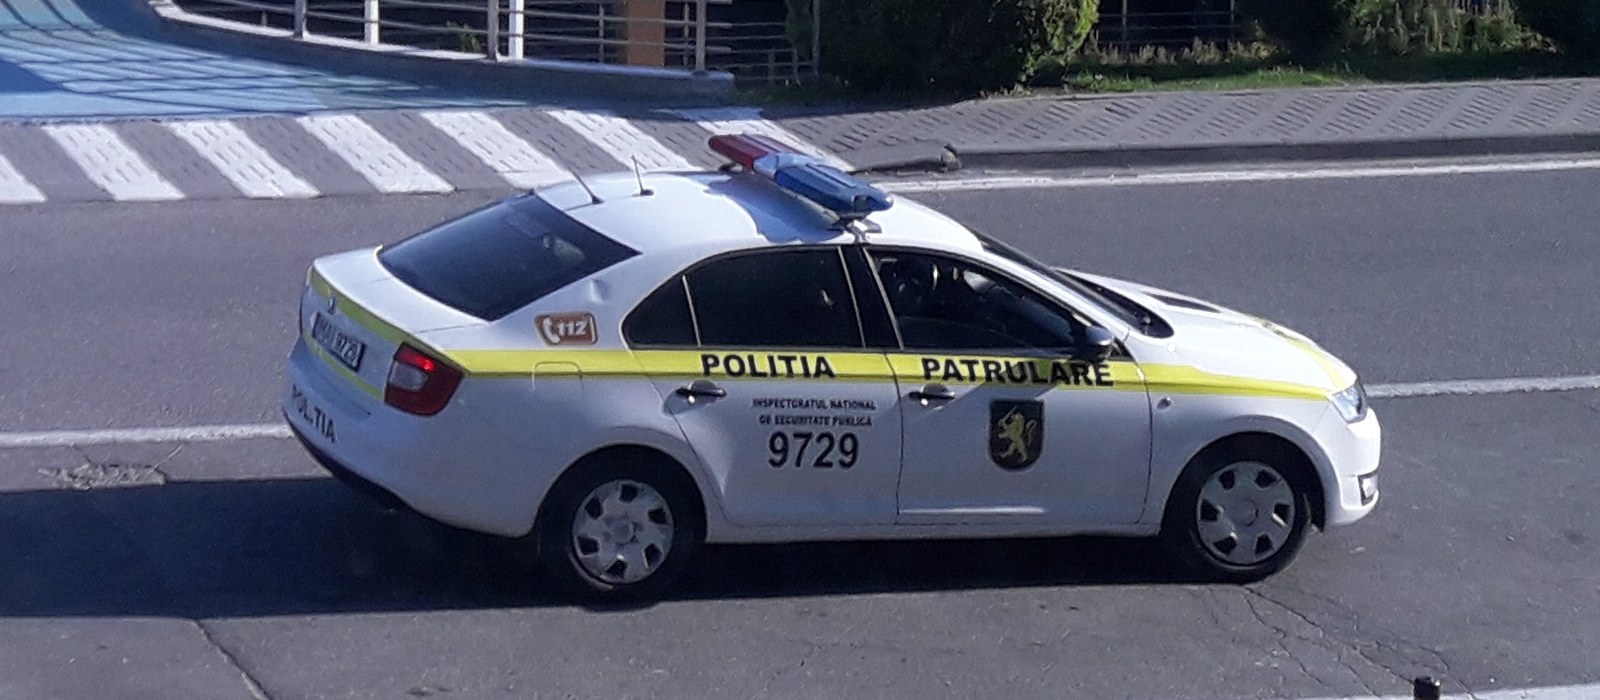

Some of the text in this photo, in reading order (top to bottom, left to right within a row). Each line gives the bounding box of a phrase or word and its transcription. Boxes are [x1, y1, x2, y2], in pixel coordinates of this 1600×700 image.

[558, 320, 588, 337] 112
[700, 353, 837, 378] POLITIA
[921, 357, 1114, 387] PATRULARE
[292, 384, 336, 443] POLTIA
[768, 431, 860, 469] 9729
